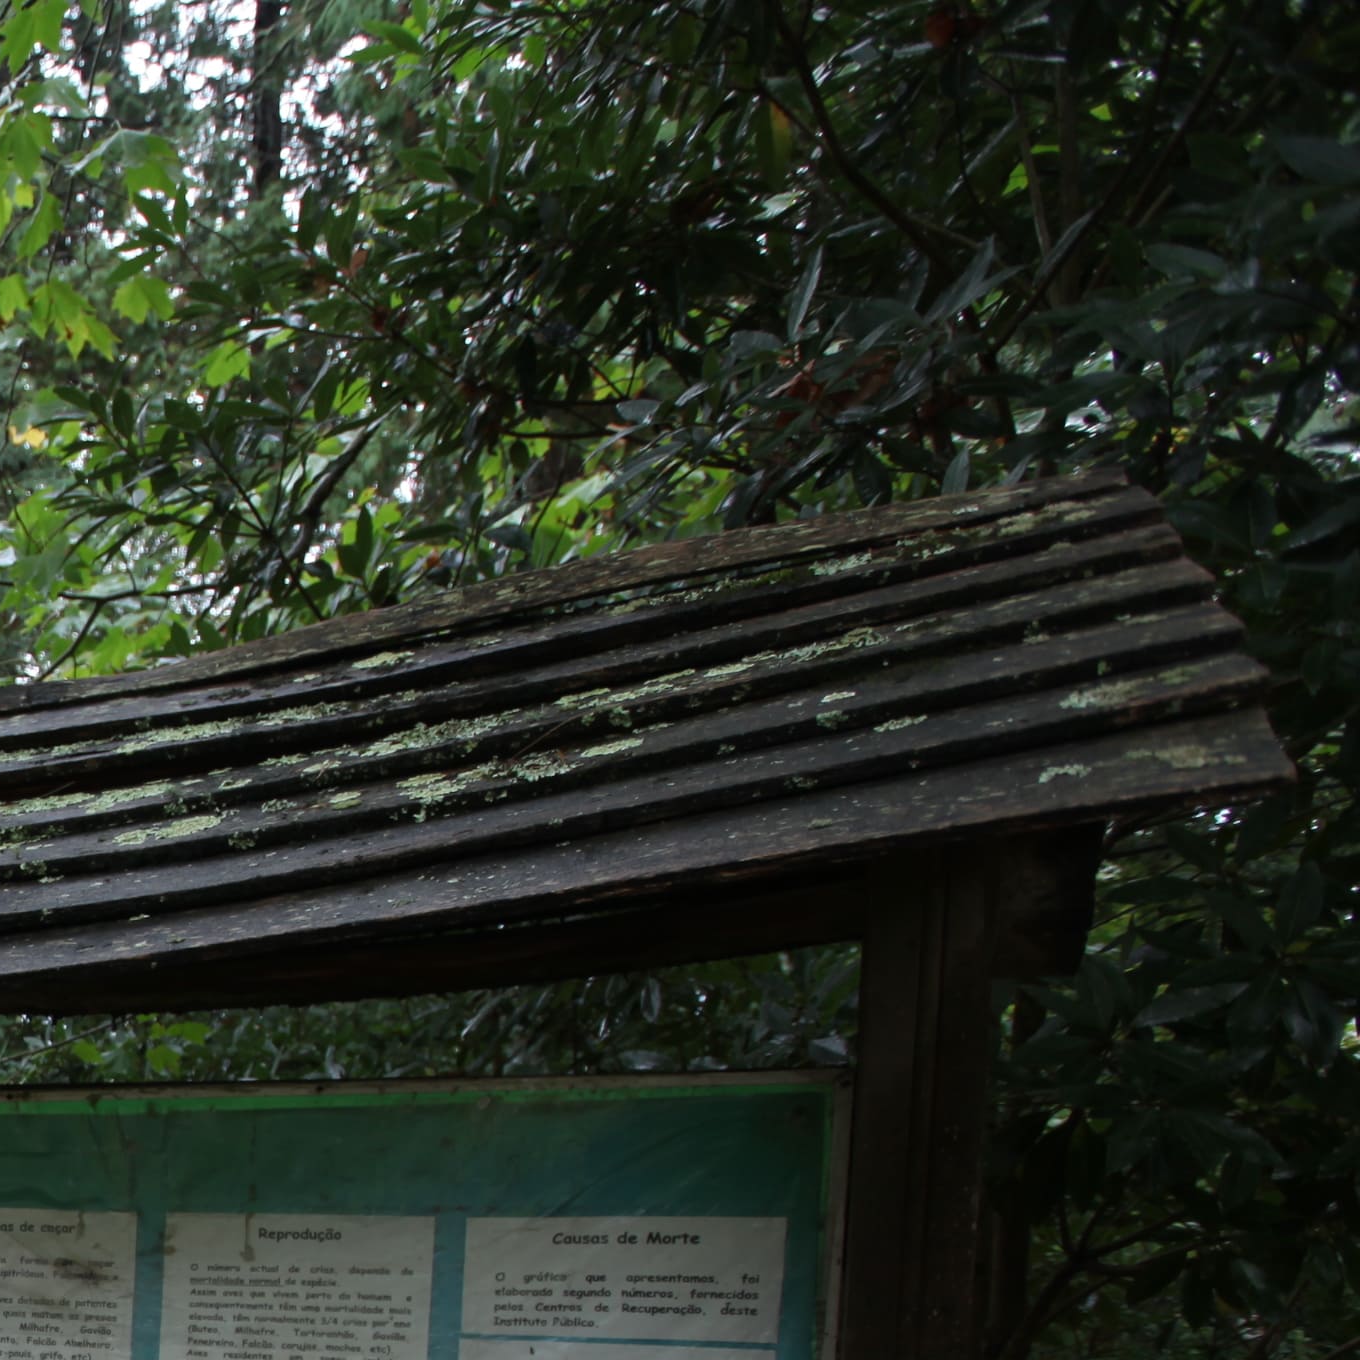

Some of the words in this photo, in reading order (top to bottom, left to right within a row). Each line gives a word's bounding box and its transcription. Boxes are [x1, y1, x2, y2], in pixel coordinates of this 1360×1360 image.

[20, 1221, 34, 1232] de
[40, 1223, 76, 1234] caçar
[258, 1228, 342, 1242] Reprodução
[552, 1232, 609, 1245] Causas
[617, 1232, 637, 1245] de
[647, 1232, 700, 1245] Morte
[523, 1272, 567, 1285] gráfico
[585, 1273, 607, 1286] que
[626, 1273, 718, 1286] apresentamos,
[742, 1273, 759, 1285] foi
[494, 1287, 553, 1298] elaborado
[563, 1288, 611, 1300] segundo
[622, 1288, 677, 1300] números,
[690, 1288, 759, 1300] fornecidos
[494, 1302, 524, 1315] pelos
[535, 1302, 582, 1313] Centros
[594, 1303, 609, 1313] de
[622, 1303, 705, 1317] Recuperação,
[721, 1302, 758, 1316] deste
[493, 1316, 547, 1328] Instituto
[552, 1316, 599, 1329] Público.
